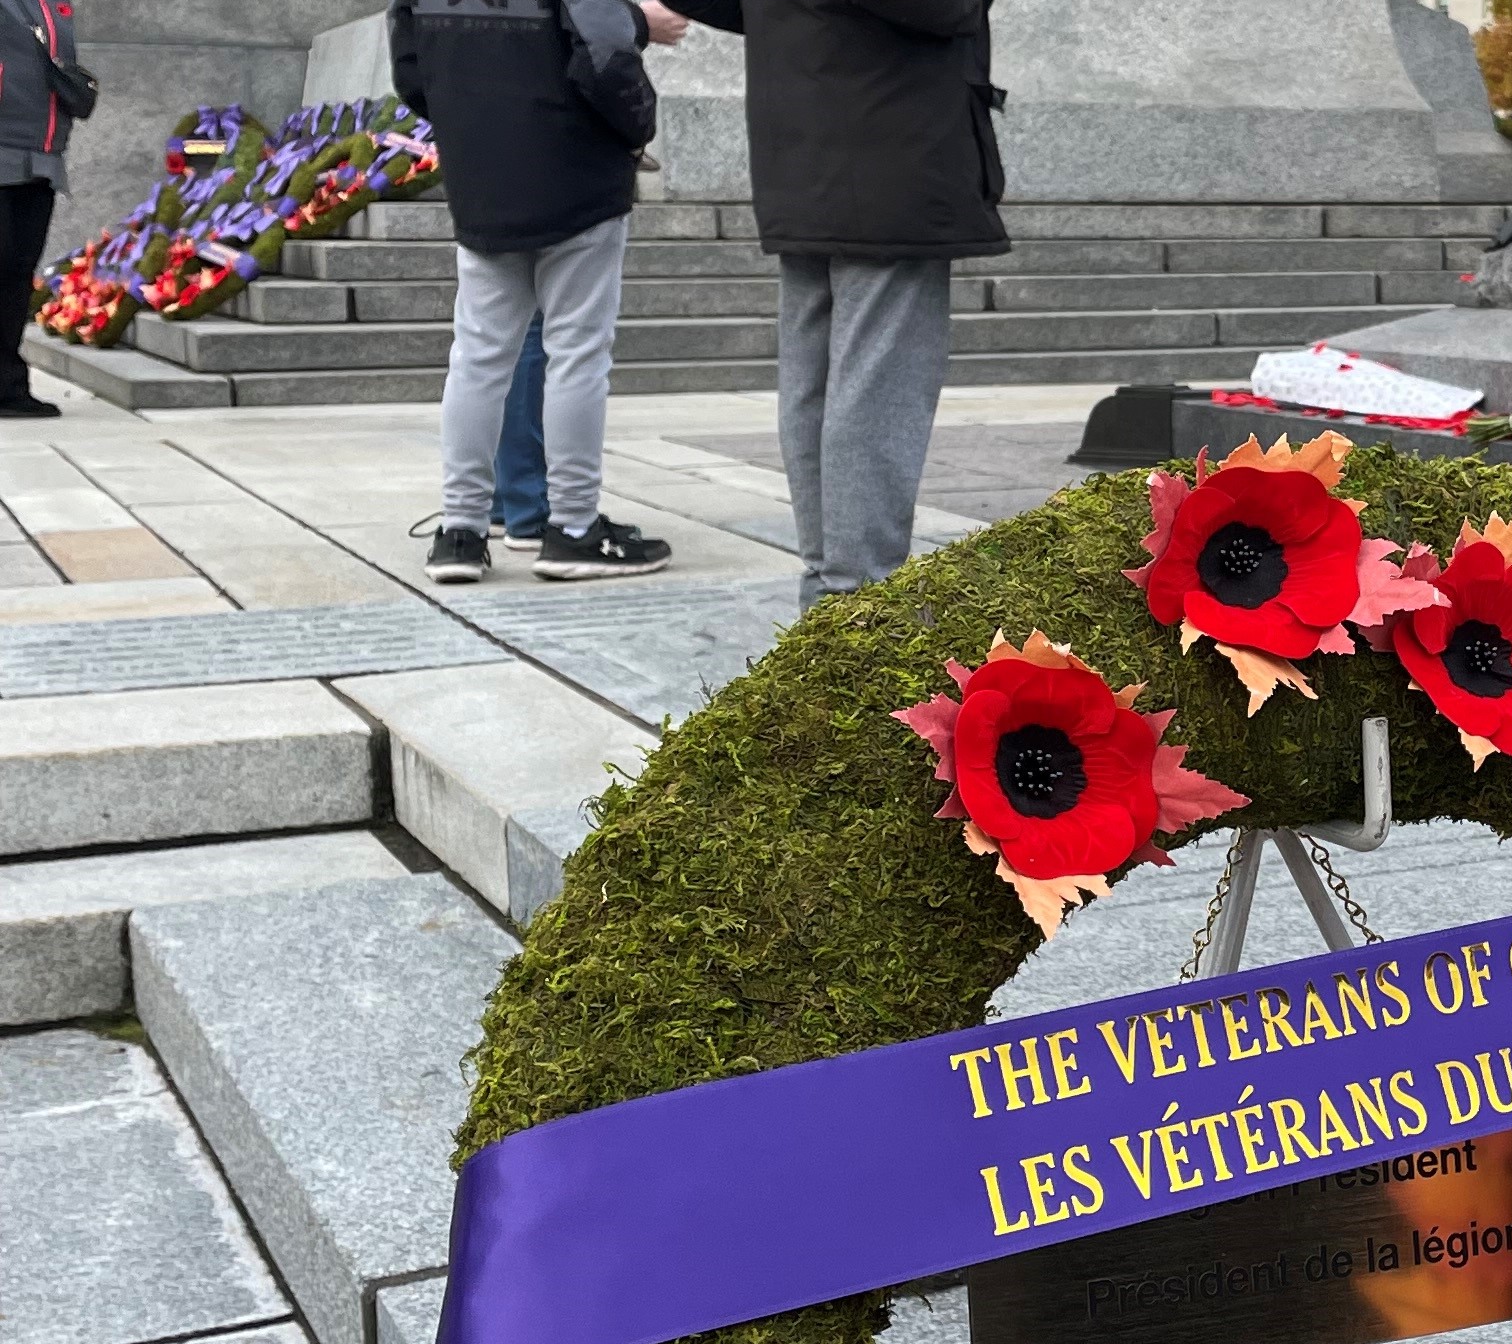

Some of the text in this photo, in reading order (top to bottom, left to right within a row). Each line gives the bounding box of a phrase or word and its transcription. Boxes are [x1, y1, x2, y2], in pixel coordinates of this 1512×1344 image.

[950, 1027, 1092, 1119] THE
[1096, 960, 1412, 1085] VETERANS
[1424, 941, 1492, 1014] OF
[979, 1144, 1105, 1237] LES
[1109, 1069, 1429, 1200] VÉTÉRANS
[1086, 1252, 1289, 1320] Président
[1302, 1245, 1354, 1283] de
[1366, 1236, 1400, 1273] la
